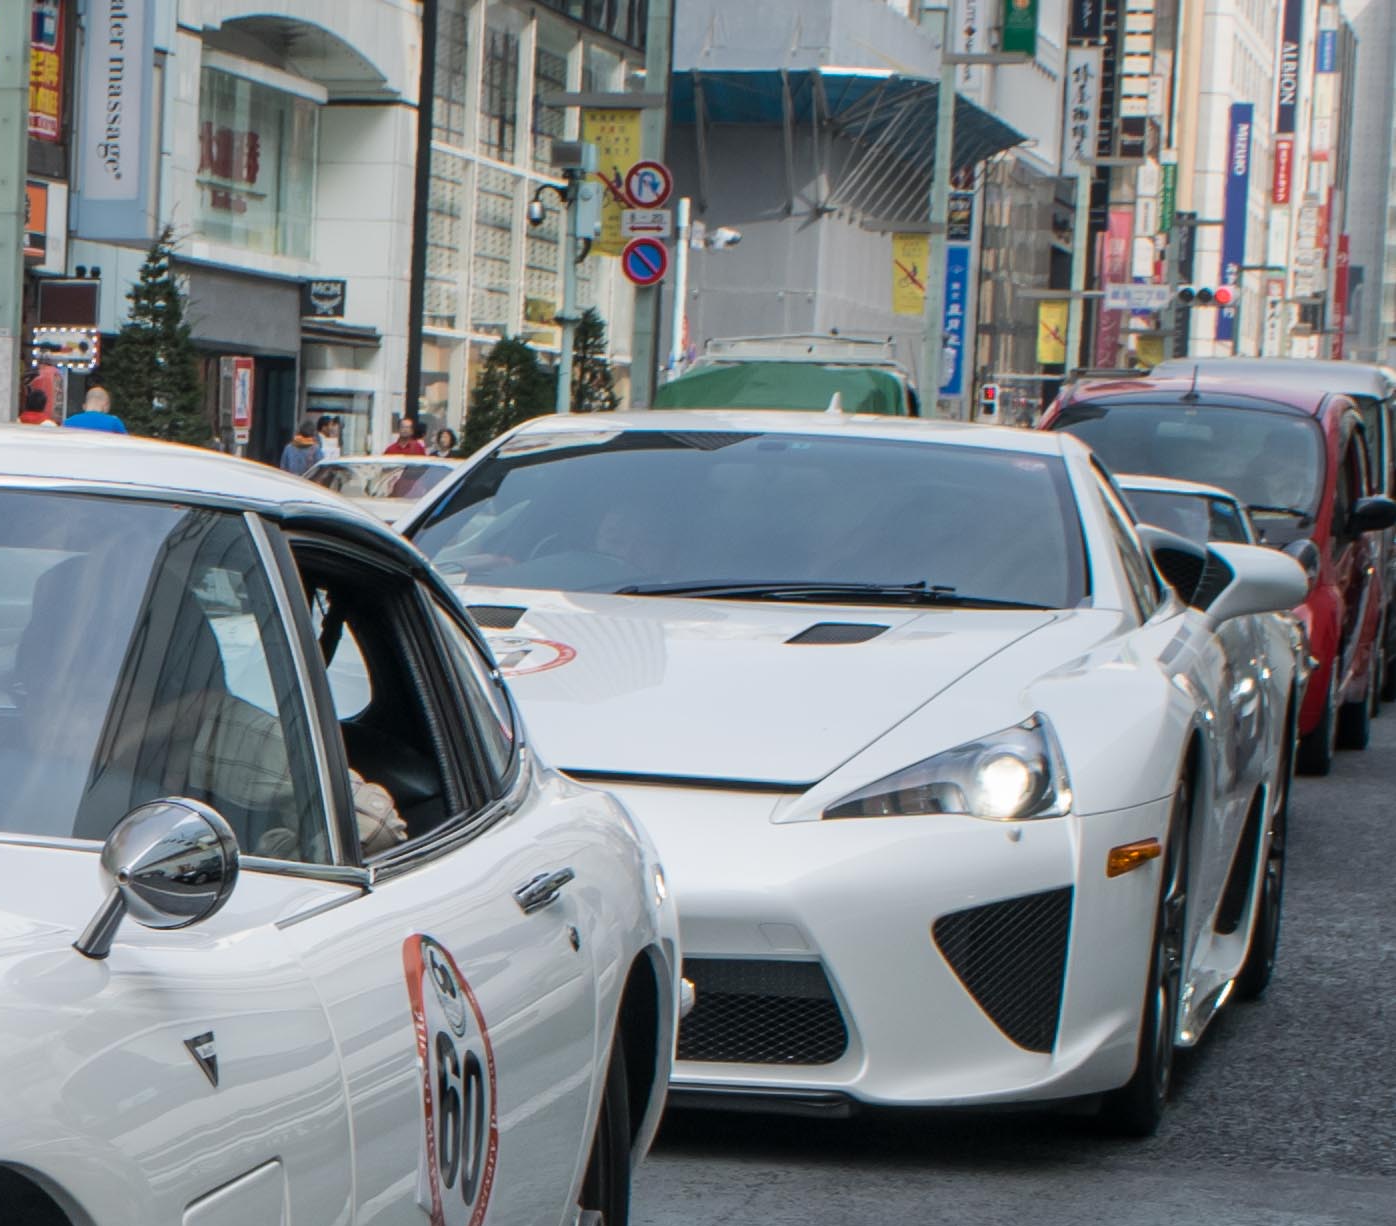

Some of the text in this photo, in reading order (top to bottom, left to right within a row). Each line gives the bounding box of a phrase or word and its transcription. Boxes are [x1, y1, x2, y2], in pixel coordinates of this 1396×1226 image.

[1280, 41, 1299, 105] ALBION
[1232, 123, 1250, 176] MIZUNO
[435, 1031, 485, 1207] 60
